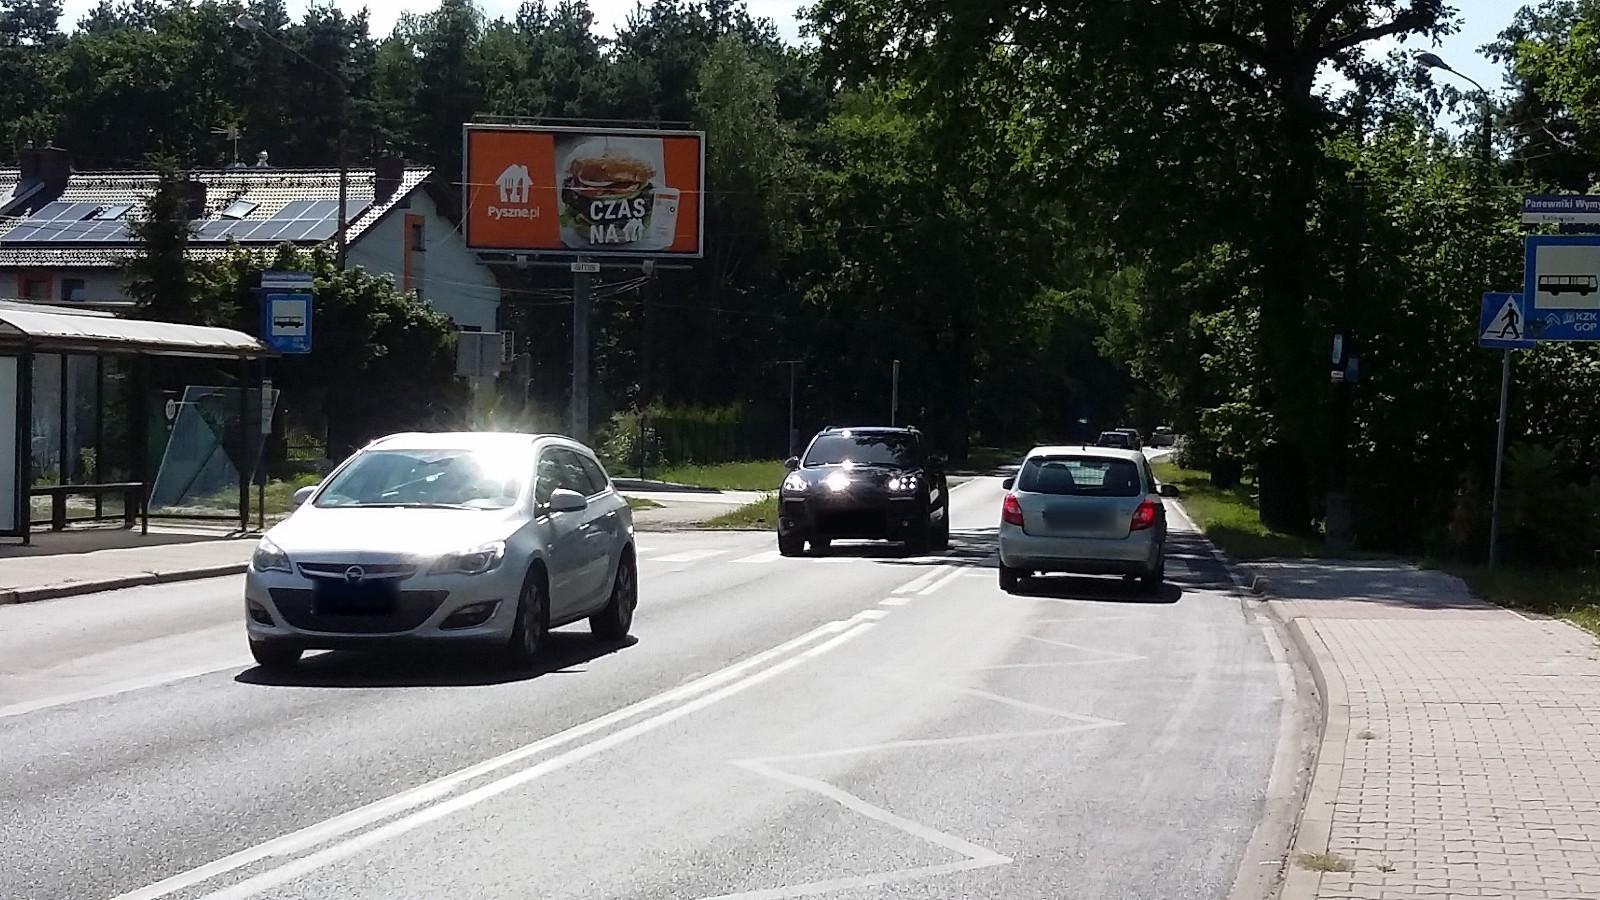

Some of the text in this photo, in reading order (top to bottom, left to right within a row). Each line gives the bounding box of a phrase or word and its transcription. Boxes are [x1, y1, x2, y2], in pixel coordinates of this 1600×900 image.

[488, 206, 540, 220] Pyszne.pl
[590, 198, 646, 220] CZAS
[590, 223, 619, 244] NA
[1576, 312, 1598, 321] KZK
[1574, 322, 1598, 332] GOP
